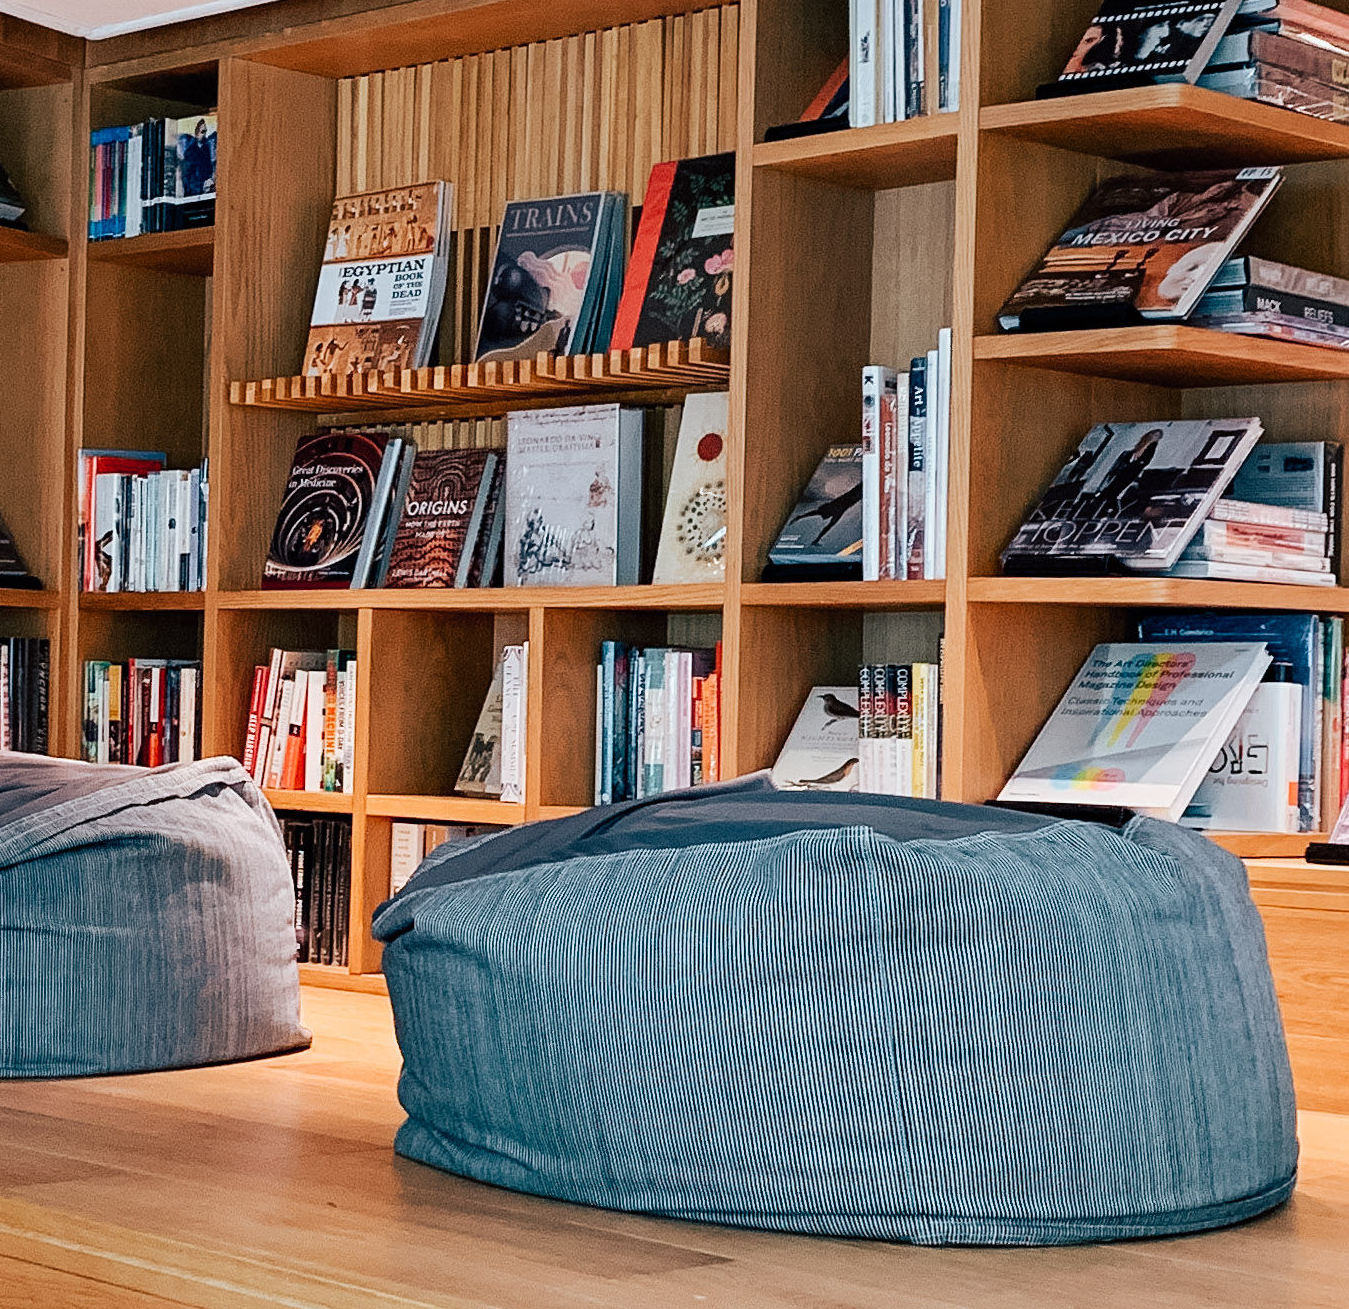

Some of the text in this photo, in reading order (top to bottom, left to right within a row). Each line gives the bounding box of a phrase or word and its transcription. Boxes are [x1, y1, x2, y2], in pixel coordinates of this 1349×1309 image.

[510, 201, 593, 230] TRAINS
[1126, 217, 1182, 230] LIVING
[1070, 225, 1219, 246] MEXICO CITY
[343, 258, 426, 278] EGYPTIAN
[395, 271, 424, 282] BOOK
[392, 290, 422, 299] DEAD
[914, 386, 924, 406] Art
[407, 500, 468, 516] ORIGINS
[1029, 499, 1139, 521] KELLY
[1092, 660, 1112, 668] The
[1113, 660, 1133, 668] Art
[1084, 671, 1235, 679] Handbook of Professional
[1078, 681, 1177, 690] Magazine Design
[874, 667, 887, 732] COMPLEXITY
[896, 669, 909, 732] COMPLEXITY
[1068, 697, 1204, 707] Classic Techniques and
[1138, 708, 1207, 717] Approaches
[326, 708, 336, 755] MACHINE
